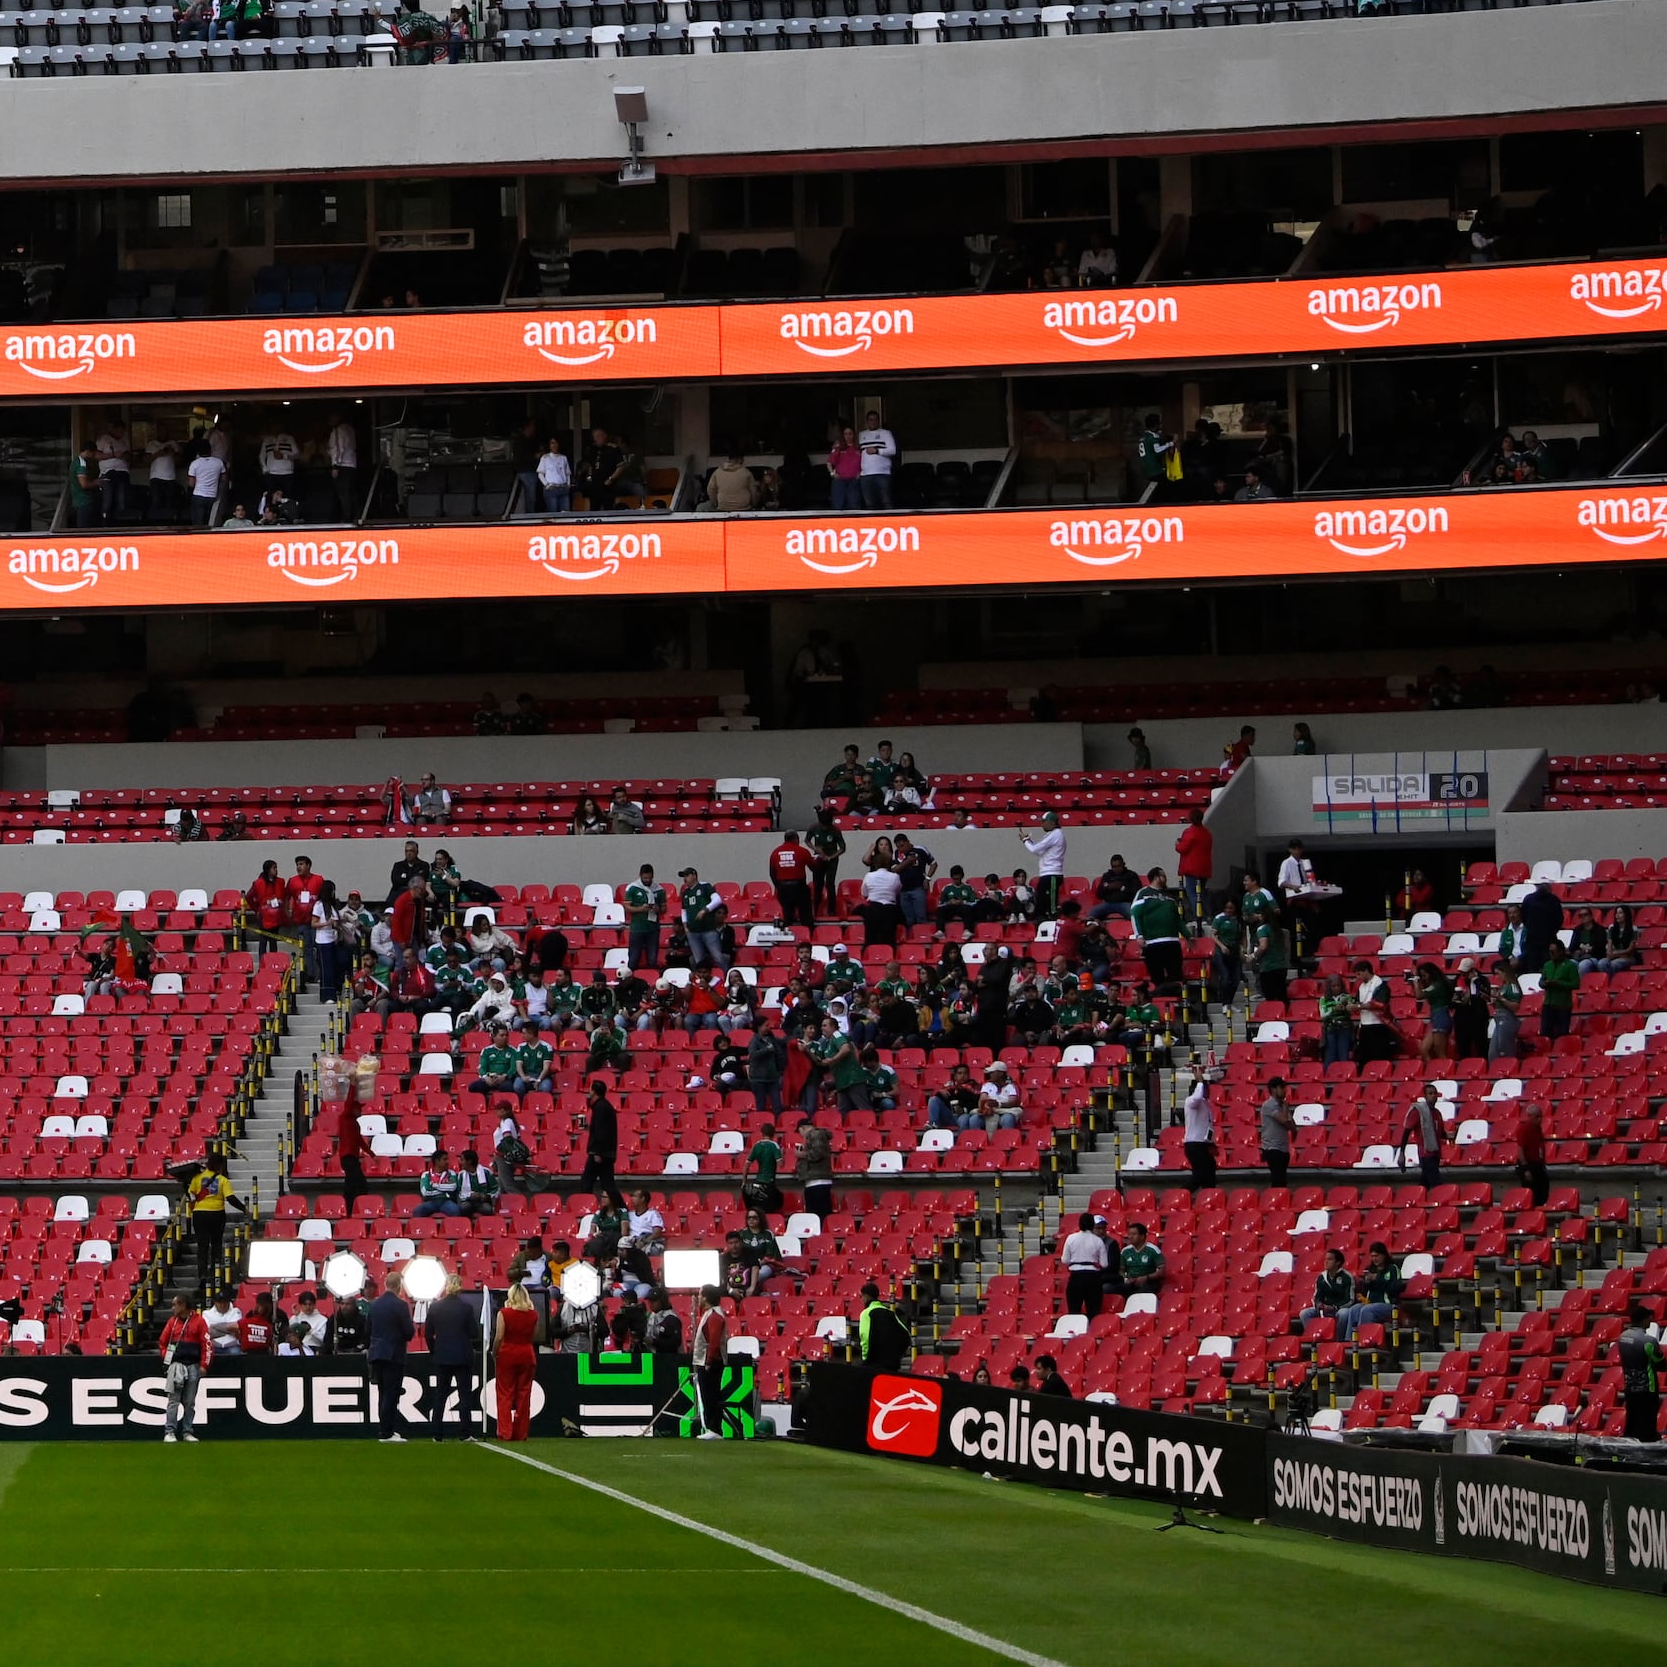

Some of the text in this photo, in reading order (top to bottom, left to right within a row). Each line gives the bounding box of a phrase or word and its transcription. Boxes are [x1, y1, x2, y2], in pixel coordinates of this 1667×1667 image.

[5, 334, 135, 360] amazon
[264, 327, 394, 353] amazon
[524, 319, 656, 346] amazon
[781, 310, 913, 338] amazon
[1044, 298, 1177, 327] amazon
[1308, 284, 1441, 314] amazon
[1571, 270, 1667, 299] amaz
[9, 547, 139, 573] amazon
[267, 540, 398, 567] amazon
[529, 534, 661, 560] amazon
[786, 527, 919, 554] amazon
[1050, 518, 1183, 546] amazon
[1315, 508, 1448, 536] amazon
[1334, 775, 1478, 798] SALIDA 20
[949, 1398, 1224, 1497] caliente.mx
[1274, 1457, 1423, 1531] SOMOS ESFUERZO
[1456, 1481, 1590, 1559] SOMOS ESFUERZO
